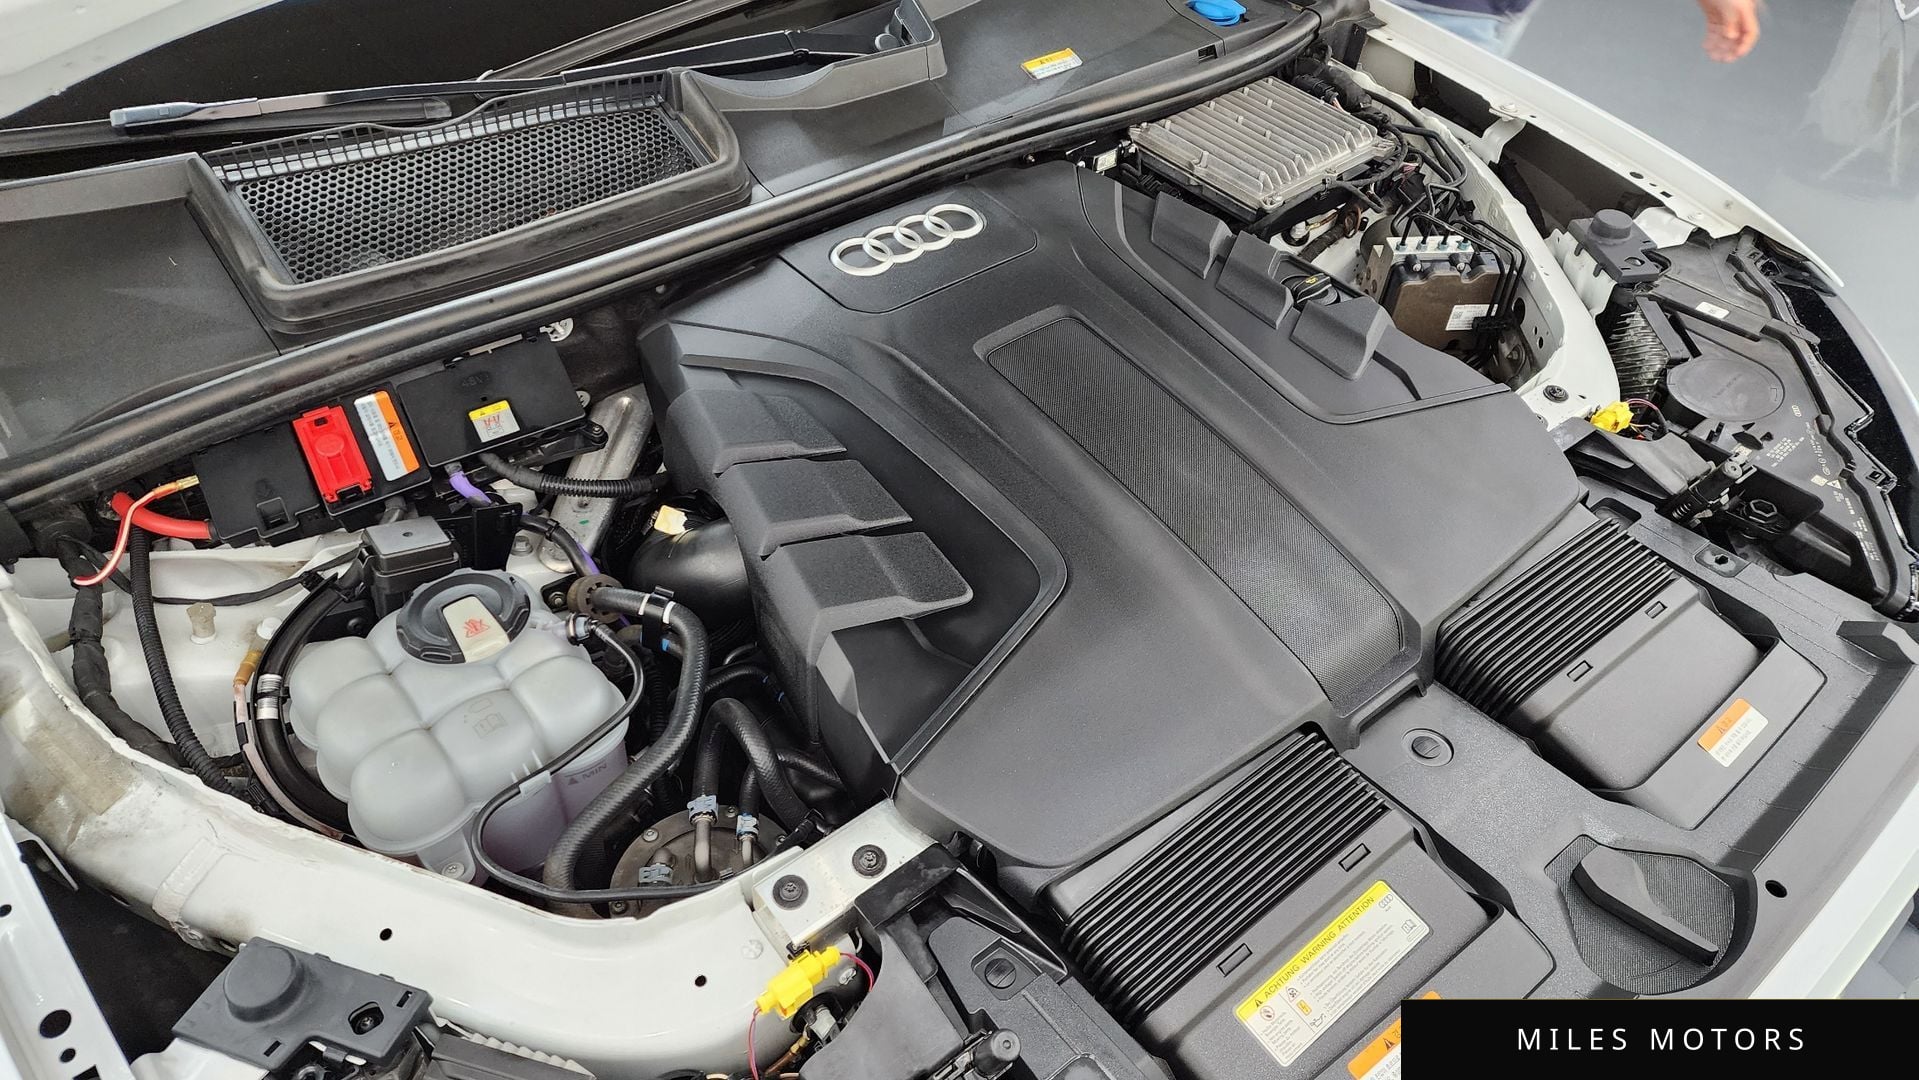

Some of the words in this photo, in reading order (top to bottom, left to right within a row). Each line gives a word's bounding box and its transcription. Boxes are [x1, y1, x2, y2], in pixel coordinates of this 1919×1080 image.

[582, 761, 607, 780] MIN
[1264, 964, 1300, 998] ACHTUNG
[1300, 930, 1337, 964] WARNING
[1337, 896, 1375, 931] ATTENTION
